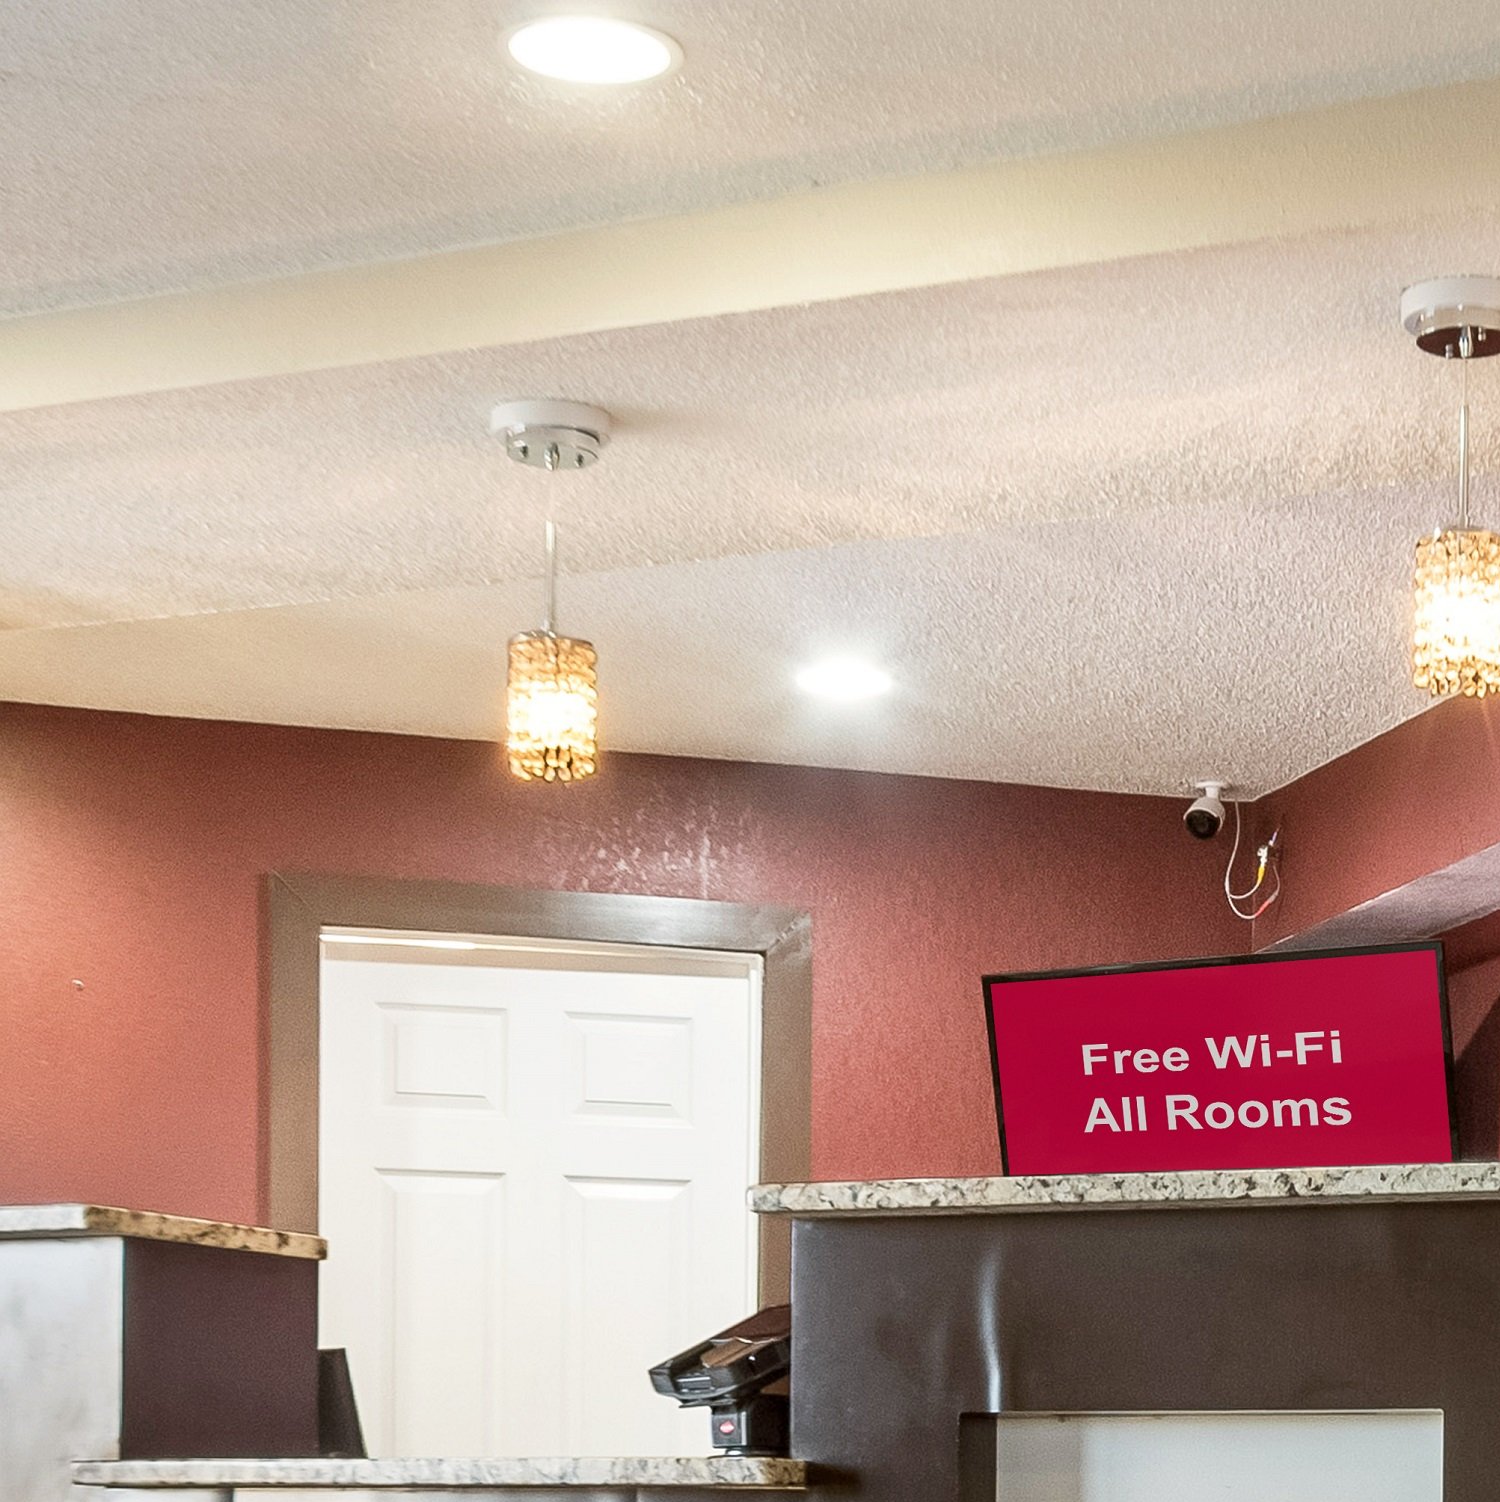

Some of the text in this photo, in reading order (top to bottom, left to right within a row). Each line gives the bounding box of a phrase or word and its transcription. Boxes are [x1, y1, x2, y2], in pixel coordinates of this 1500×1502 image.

[1081, 1029, 1343, 1076] Free Wi-Fi
[1084, 1093, 1352, 1133] All Rooms
